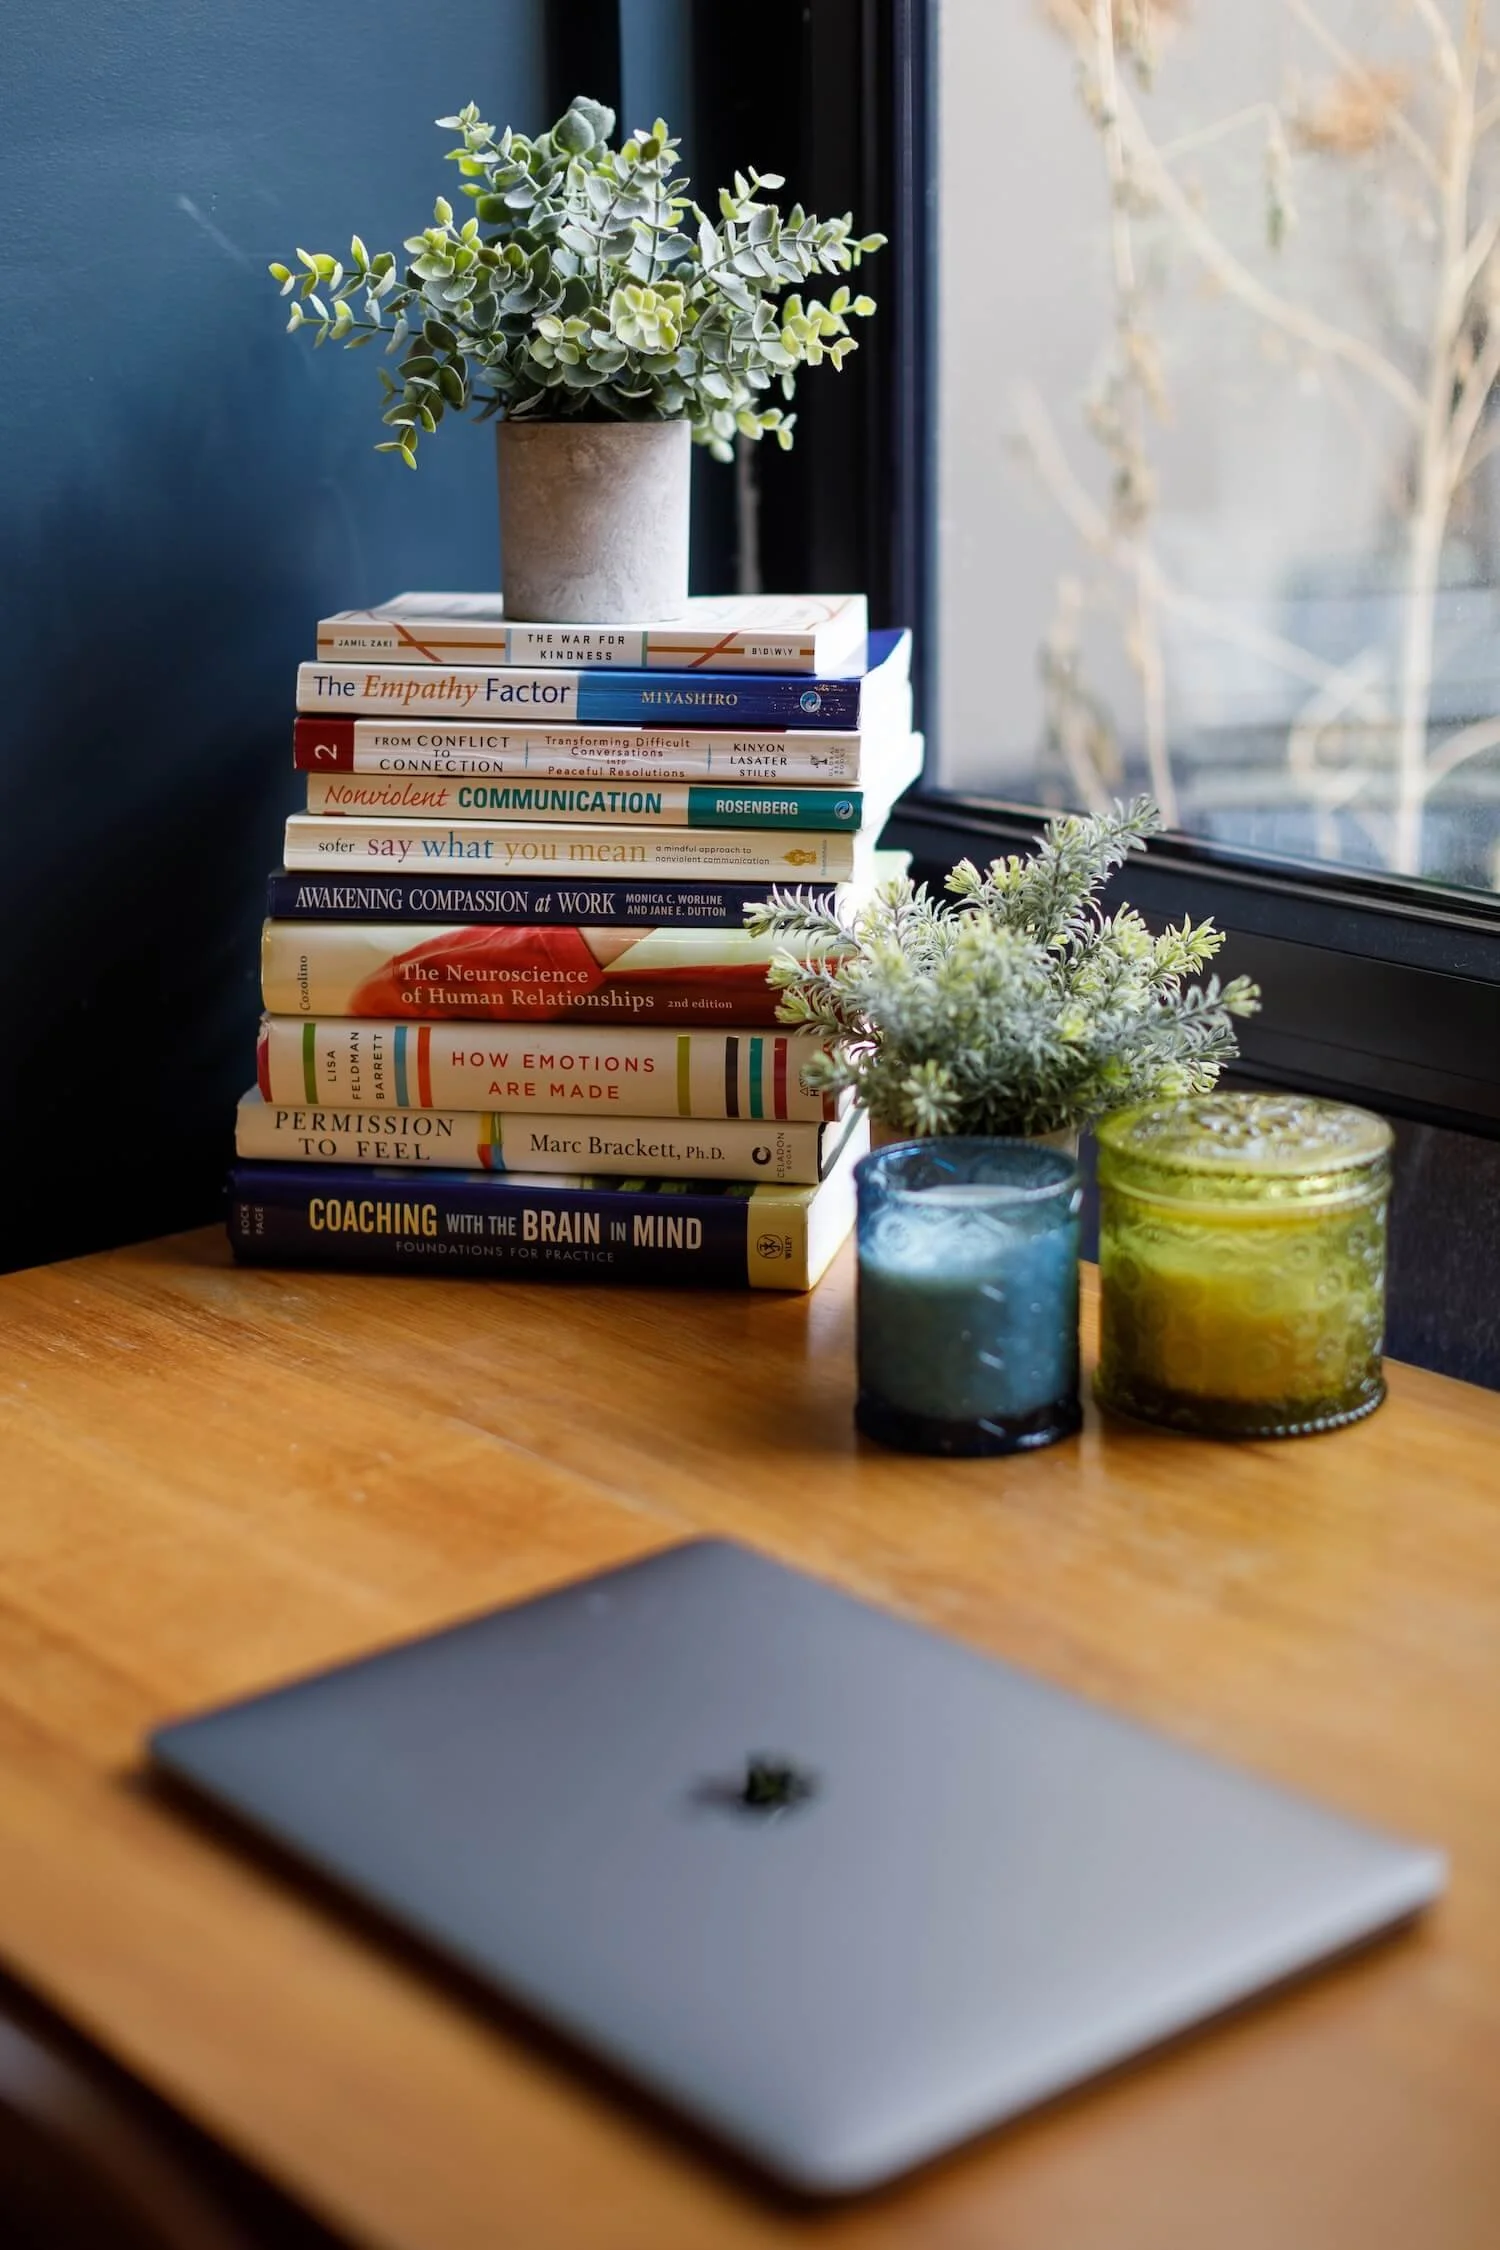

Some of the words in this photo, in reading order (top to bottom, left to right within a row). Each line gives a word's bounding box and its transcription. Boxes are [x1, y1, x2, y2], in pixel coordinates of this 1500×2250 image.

[338, 639, 367, 648] JAMIL
[370, 640, 393, 648] ZAKI
[528, 634, 553, 643] THE
[561, 634, 591, 644] WAR
[599, 635, 625, 645] FOR
[540, 650, 613, 661] KINDNESS
[313, 676, 355, 698] The
[362, 674, 479, 707] Empathy
[486, 677, 571, 704] Factor
[641, 691, 738, 706] MIYASHIRO
[375, 736, 411, 746] FROM
[417, 735, 511, 748] CONFLICT
[545, 736, 629, 748] Transforming
[636, 737, 690, 748] Difficult
[733, 743, 786, 753] KINYON
[314, 743, 338, 760] 2
[433, 750, 450, 758] TO
[571, 747, 664, 757] Conversations
[379, 759, 504, 773] CONNECTION
[730, 756, 788, 766] LASATER
[548, 766, 603, 777] Peaceful
[609, 767, 686, 778] Resolutions
[739, 769, 777, 778] STILES
[324, 784, 450, 807] Nonviolent
[458, 787, 661, 814] COMMUNICATION
[716, 799, 799, 816] ROSENBERG
[317, 838, 355, 853] sofer
[367, 838, 414, 863] say
[421, 831, 495, 859] what
[504, 843, 558, 866] you
[568, 844, 647, 863] mean
[663, 845, 697, 853] mindful
[699, 846, 740, 855] approach
[655, 856, 701, 864] nonviolent
[703, 856, 770, 865] communication
[295, 886, 403, 910] AWAKENING
[409, 888, 528, 913] COMPASSION
[534, 892, 552, 913] at
[557, 892, 616, 915] WORK
[626, 893, 663, 904] MONICA
[666, 894, 676, 904] C.
[678, 894, 723, 905] WORLINE
[627, 904, 648, 915] AND
[650, 905, 675, 916] JANE
[676, 906, 685, 916] E.
[687, 906, 727, 917] DUTTON
[401, 963, 439, 981] The
[446, 964, 589, 983] Neuroscience
[297, 955, 311, 1011] Cozolino
[401, 987, 423, 1004] of
[428, 987, 504, 1006] Human
[511, 989, 655, 1013] Relationships
[667, 998, 689, 1009] 2nd
[691, 999, 733, 1010] edition
[327, 1050, 337, 1082] LISA
[350, 1031, 362, 1100] FELDMAN
[373, 1034, 385, 1100] BARRETT
[452, 1052, 509, 1068] HOW
[523, 1054, 655, 1073] EMOTIONS
[488, 1081, 536, 1096] ARE
[550, 1084, 620, 1100] MADE
[274, 1110, 455, 1137] PERMISSION
[299, 1138, 337, 1156] TO
[356, 1141, 430, 1161] FEEL
[530, 1134, 582, 1154] Marc
[587, 1136, 681, 1161] Brackett,
[685, 1145, 726, 1161] Ph.D.
[776, 1131, 785, 1178] CELADON
[308, 1198, 437, 1237] COACHING
[446, 1213, 483, 1235] WITH
[488, 1215, 517, 1236] THE
[523, 1209, 600, 1245] BRAIN
[610, 1221, 627, 1241] IN
[633, 1214, 702, 1250] MIND
[395, 1240, 503, 1257] FOUNDATIONS
[509, 1247, 538, 1258] FOR
[545, 1249, 614, 1263] PRACTICE
[784, 1235, 793, 1259] WILEY
